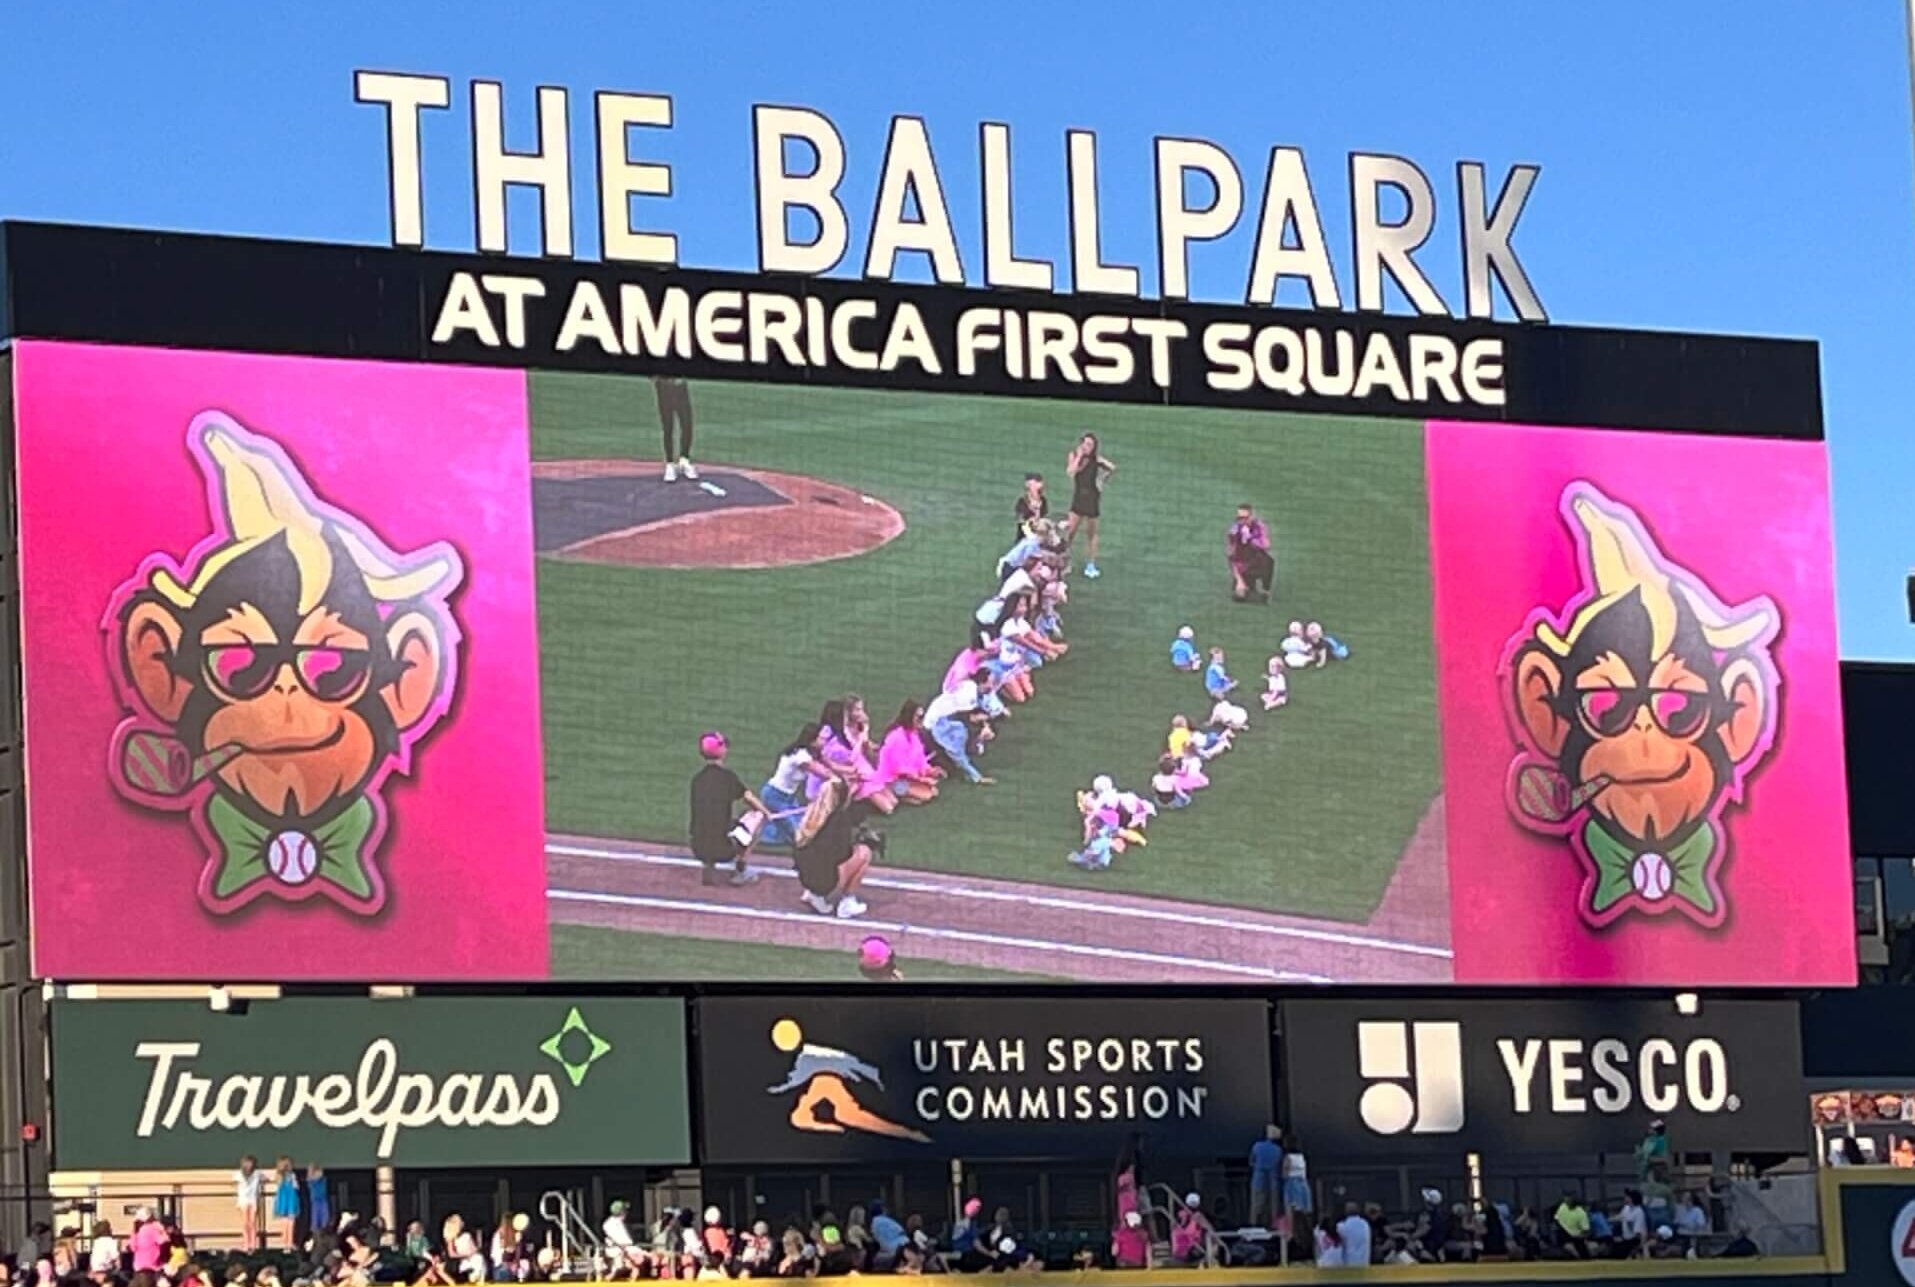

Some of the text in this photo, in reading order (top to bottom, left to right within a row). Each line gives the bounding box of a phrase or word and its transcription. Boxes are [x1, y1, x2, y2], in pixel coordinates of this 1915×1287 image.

[353, 70, 1549, 323] THE BALLPARK
[432, 272, 1506, 405] AT AMERICA FIRST SQUARE
[135, 1038, 560, 1158] Travelpass
[913, 1038, 1204, 1073] UTAH SPORTS
[916, 1085, 1202, 1120] COMMISSION
